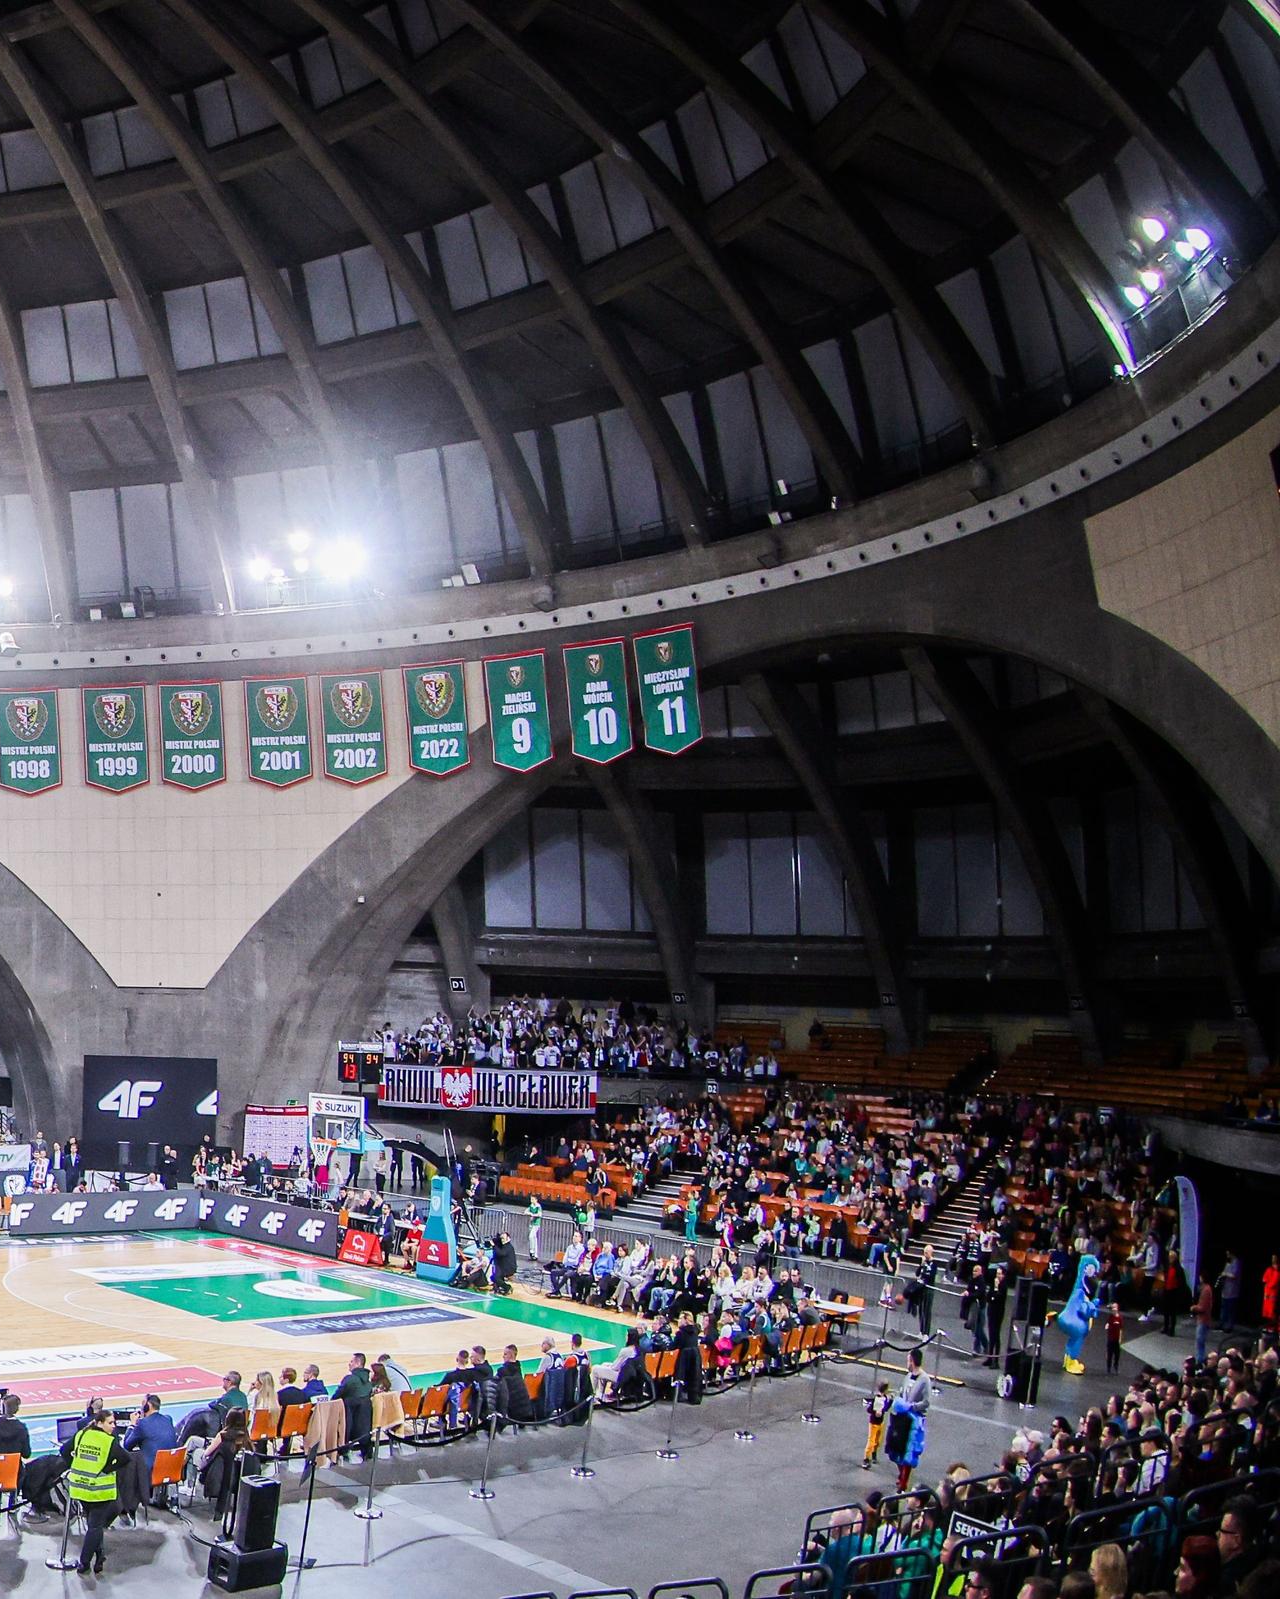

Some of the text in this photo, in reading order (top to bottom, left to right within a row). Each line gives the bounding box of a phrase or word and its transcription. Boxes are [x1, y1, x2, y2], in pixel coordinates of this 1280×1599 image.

[586, 681, 608, 693] ADAM
[652, 680, 684, 695] ŁOPATKA
[504, 692, 532, 704] MACIEJ
[583, 691, 613, 705] WÓJCIK
[658, 696, 687, 736] 11
[413, 723, 463, 734] MISTRZ POLSKI
[584, 707, 618, 746] 10
[252, 736, 306, 746] MISTRZ POLSKI
[327, 733, 381, 744] MISTRZ POLSKI
[512, 718, 532, 754] 9
[1, 746, 56, 756] MISTRZ POLSKI
[89, 742, 143, 752] MISTRZ POLSKI
[166, 740, 220, 750] MISTRZ POLSKI
[420, 739, 460, 758] 2022
[171, 754, 216, 774] 2000
[259, 751, 301, 770] 2001
[333, 748, 377, 768] 2002
[8, 760, 50, 779] 1998
[96, 757, 138, 777] 1999
[452, 980, 464, 988] D1
[343, 1053, 354, 1064] 94
[366, 1053, 378, 1064] 94
[344, 1064, 357, 1080] 13
[98, 1080, 162, 1118] 4F
[476, 1072, 590, 1110] WŁOCŁAWEK
[324, 1102, 357, 1114] SUZUKI
[52, 1200, 88, 1224] 4F
[104, 1199, 138, 1223] 4F
[154, 1198, 188, 1221] 4F
[224, 1204, 250, 1227] 4F
[260, 1210, 287, 1235] 4F
[298, 1218, 326, 1243] 4F
[60, 1376, 200, 1395] PARK PLAZA
